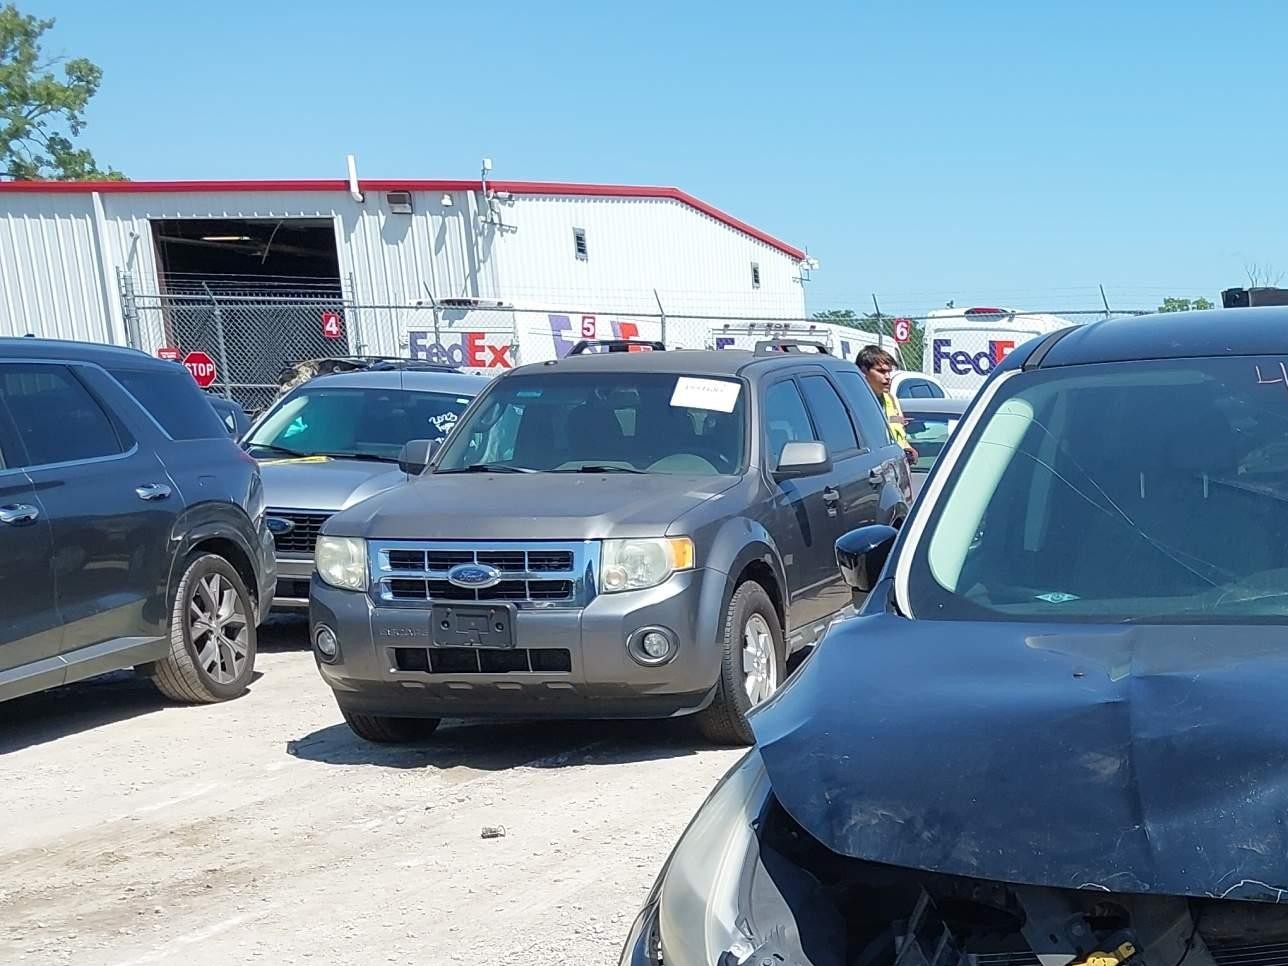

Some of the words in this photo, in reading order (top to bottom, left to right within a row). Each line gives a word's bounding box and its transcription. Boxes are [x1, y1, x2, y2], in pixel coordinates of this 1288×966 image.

[325, 316, 338, 335] 4
[583, 318, 595, 337] 5
[896, 322, 908, 341] 6
[410, 331, 512, 368] FedEx
